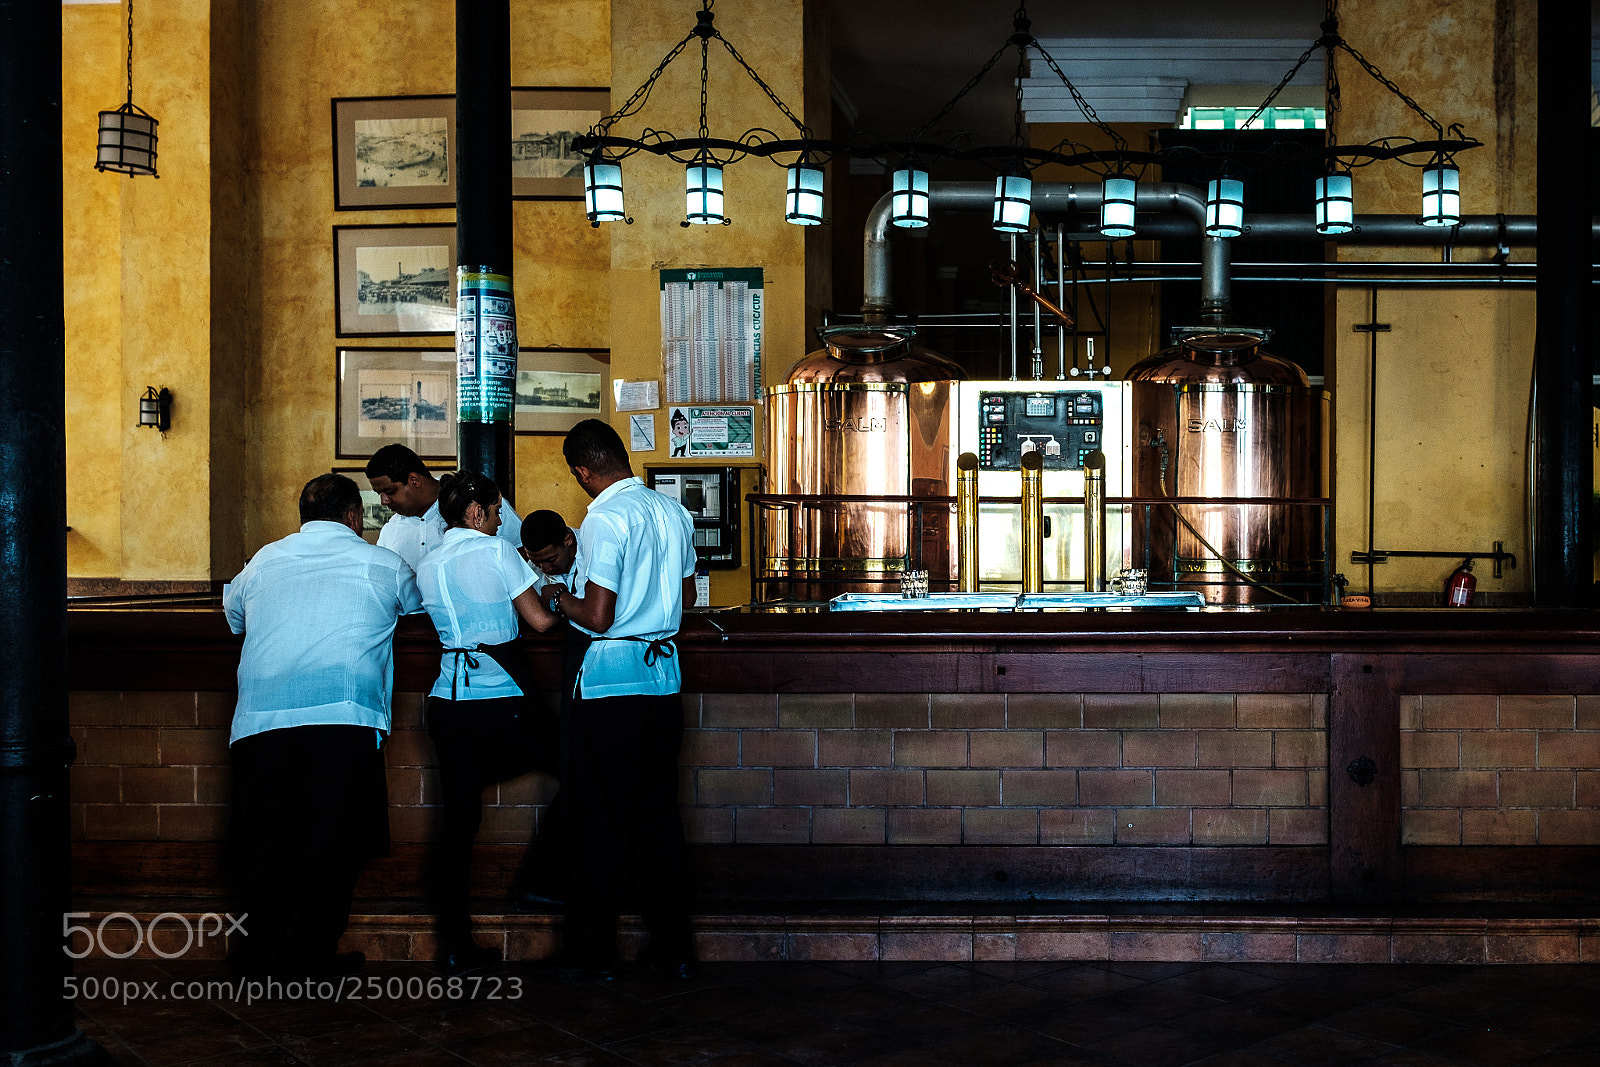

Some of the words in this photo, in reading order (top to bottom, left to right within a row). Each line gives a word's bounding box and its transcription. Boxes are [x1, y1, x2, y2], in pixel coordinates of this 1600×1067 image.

[752, 293, 761, 331] CUC/CUP
[752, 332, 762, 400] EQUIVALENCIAS
[825, 417, 886, 432] SALM
[1188, 418, 1246, 433] SALM
